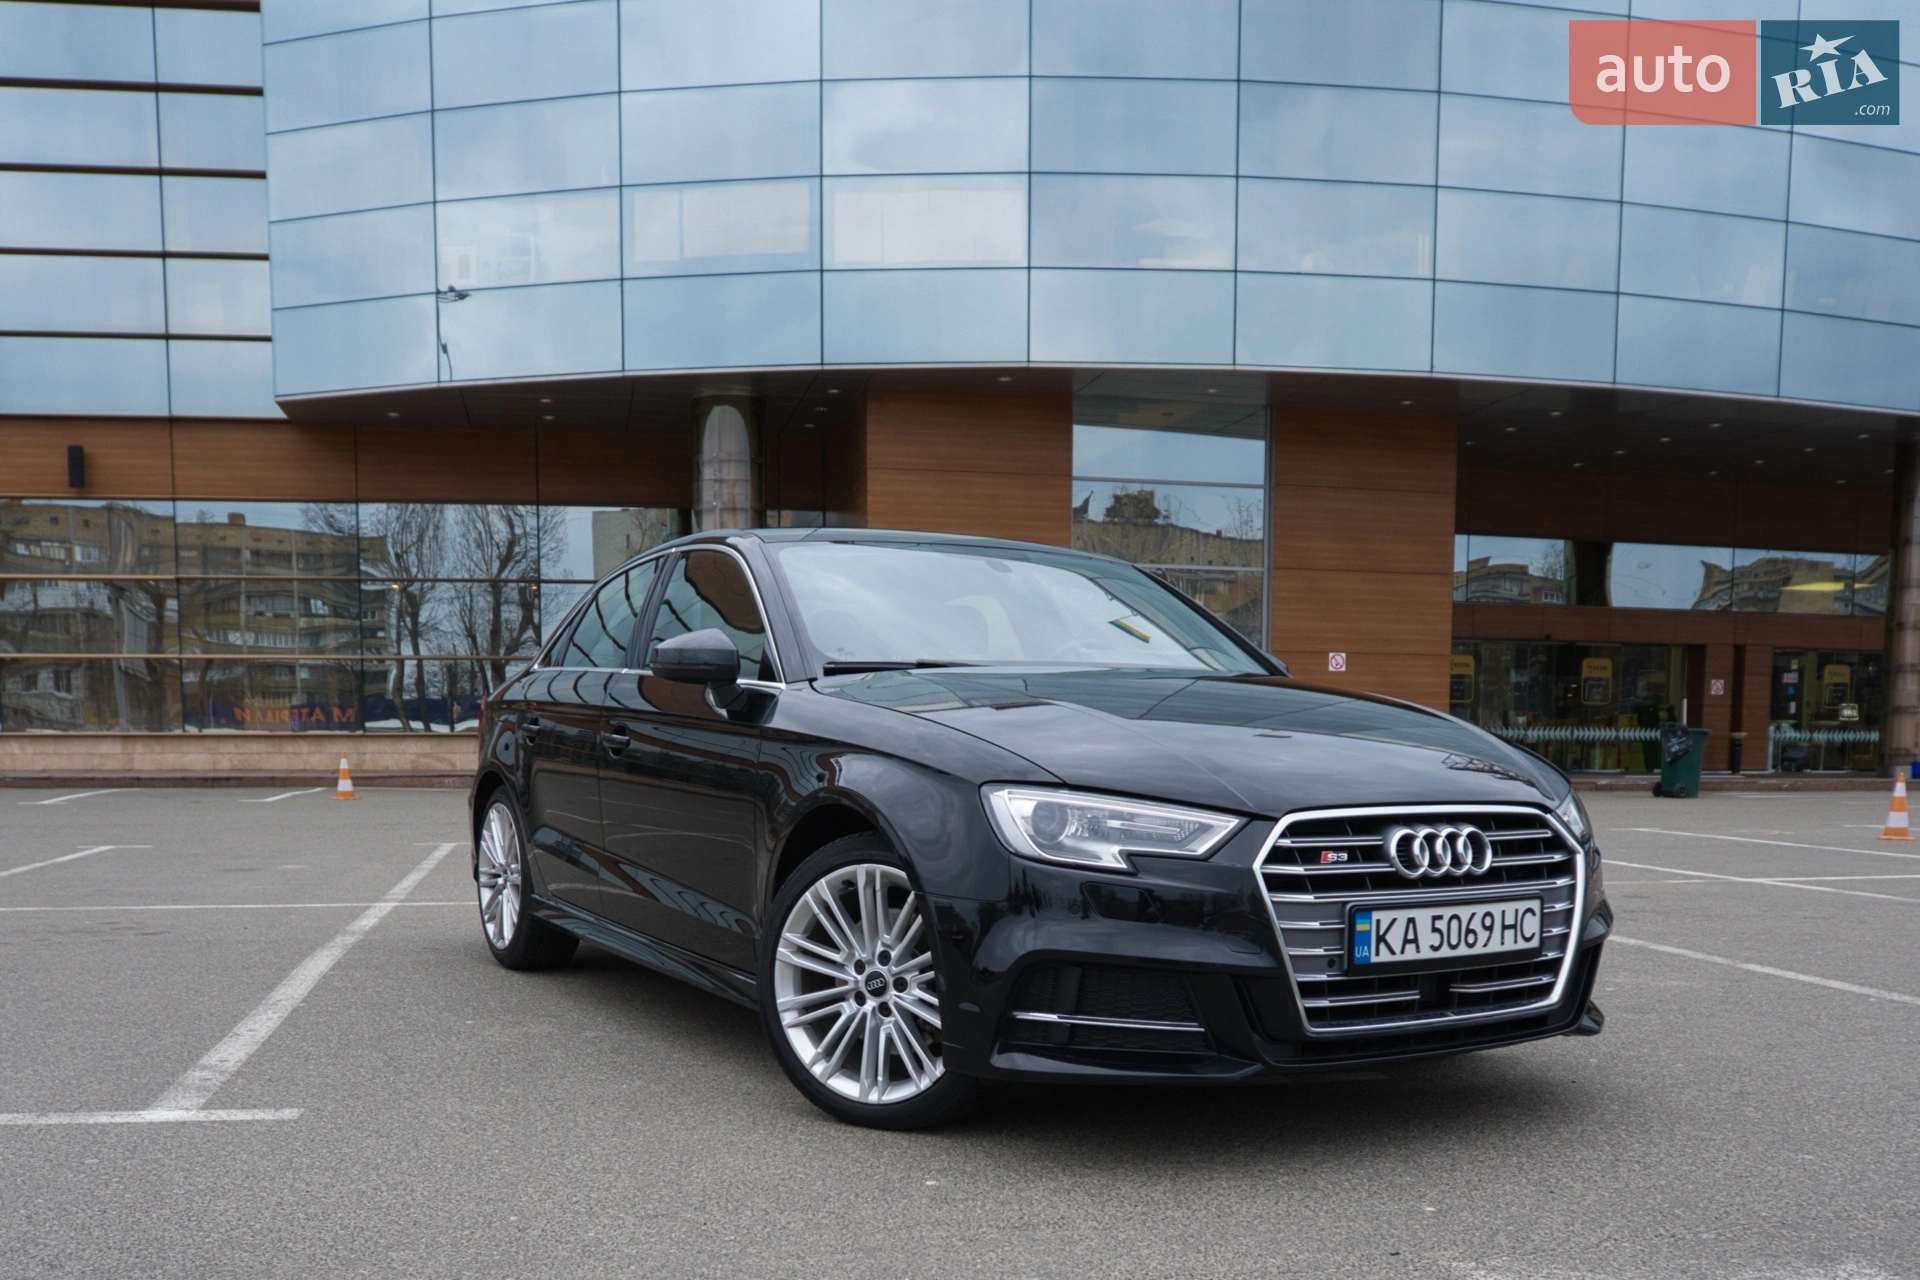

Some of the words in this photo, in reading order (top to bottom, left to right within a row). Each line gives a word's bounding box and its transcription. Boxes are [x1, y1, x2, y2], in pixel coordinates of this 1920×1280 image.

[1327, 853, 1348, 861] S3
[1375, 917, 1421, 957] KA
[1429, 911, 1495, 952] 5069
[1501, 907, 1537, 946] HC
[1355, 946, 1369, 958] UA
